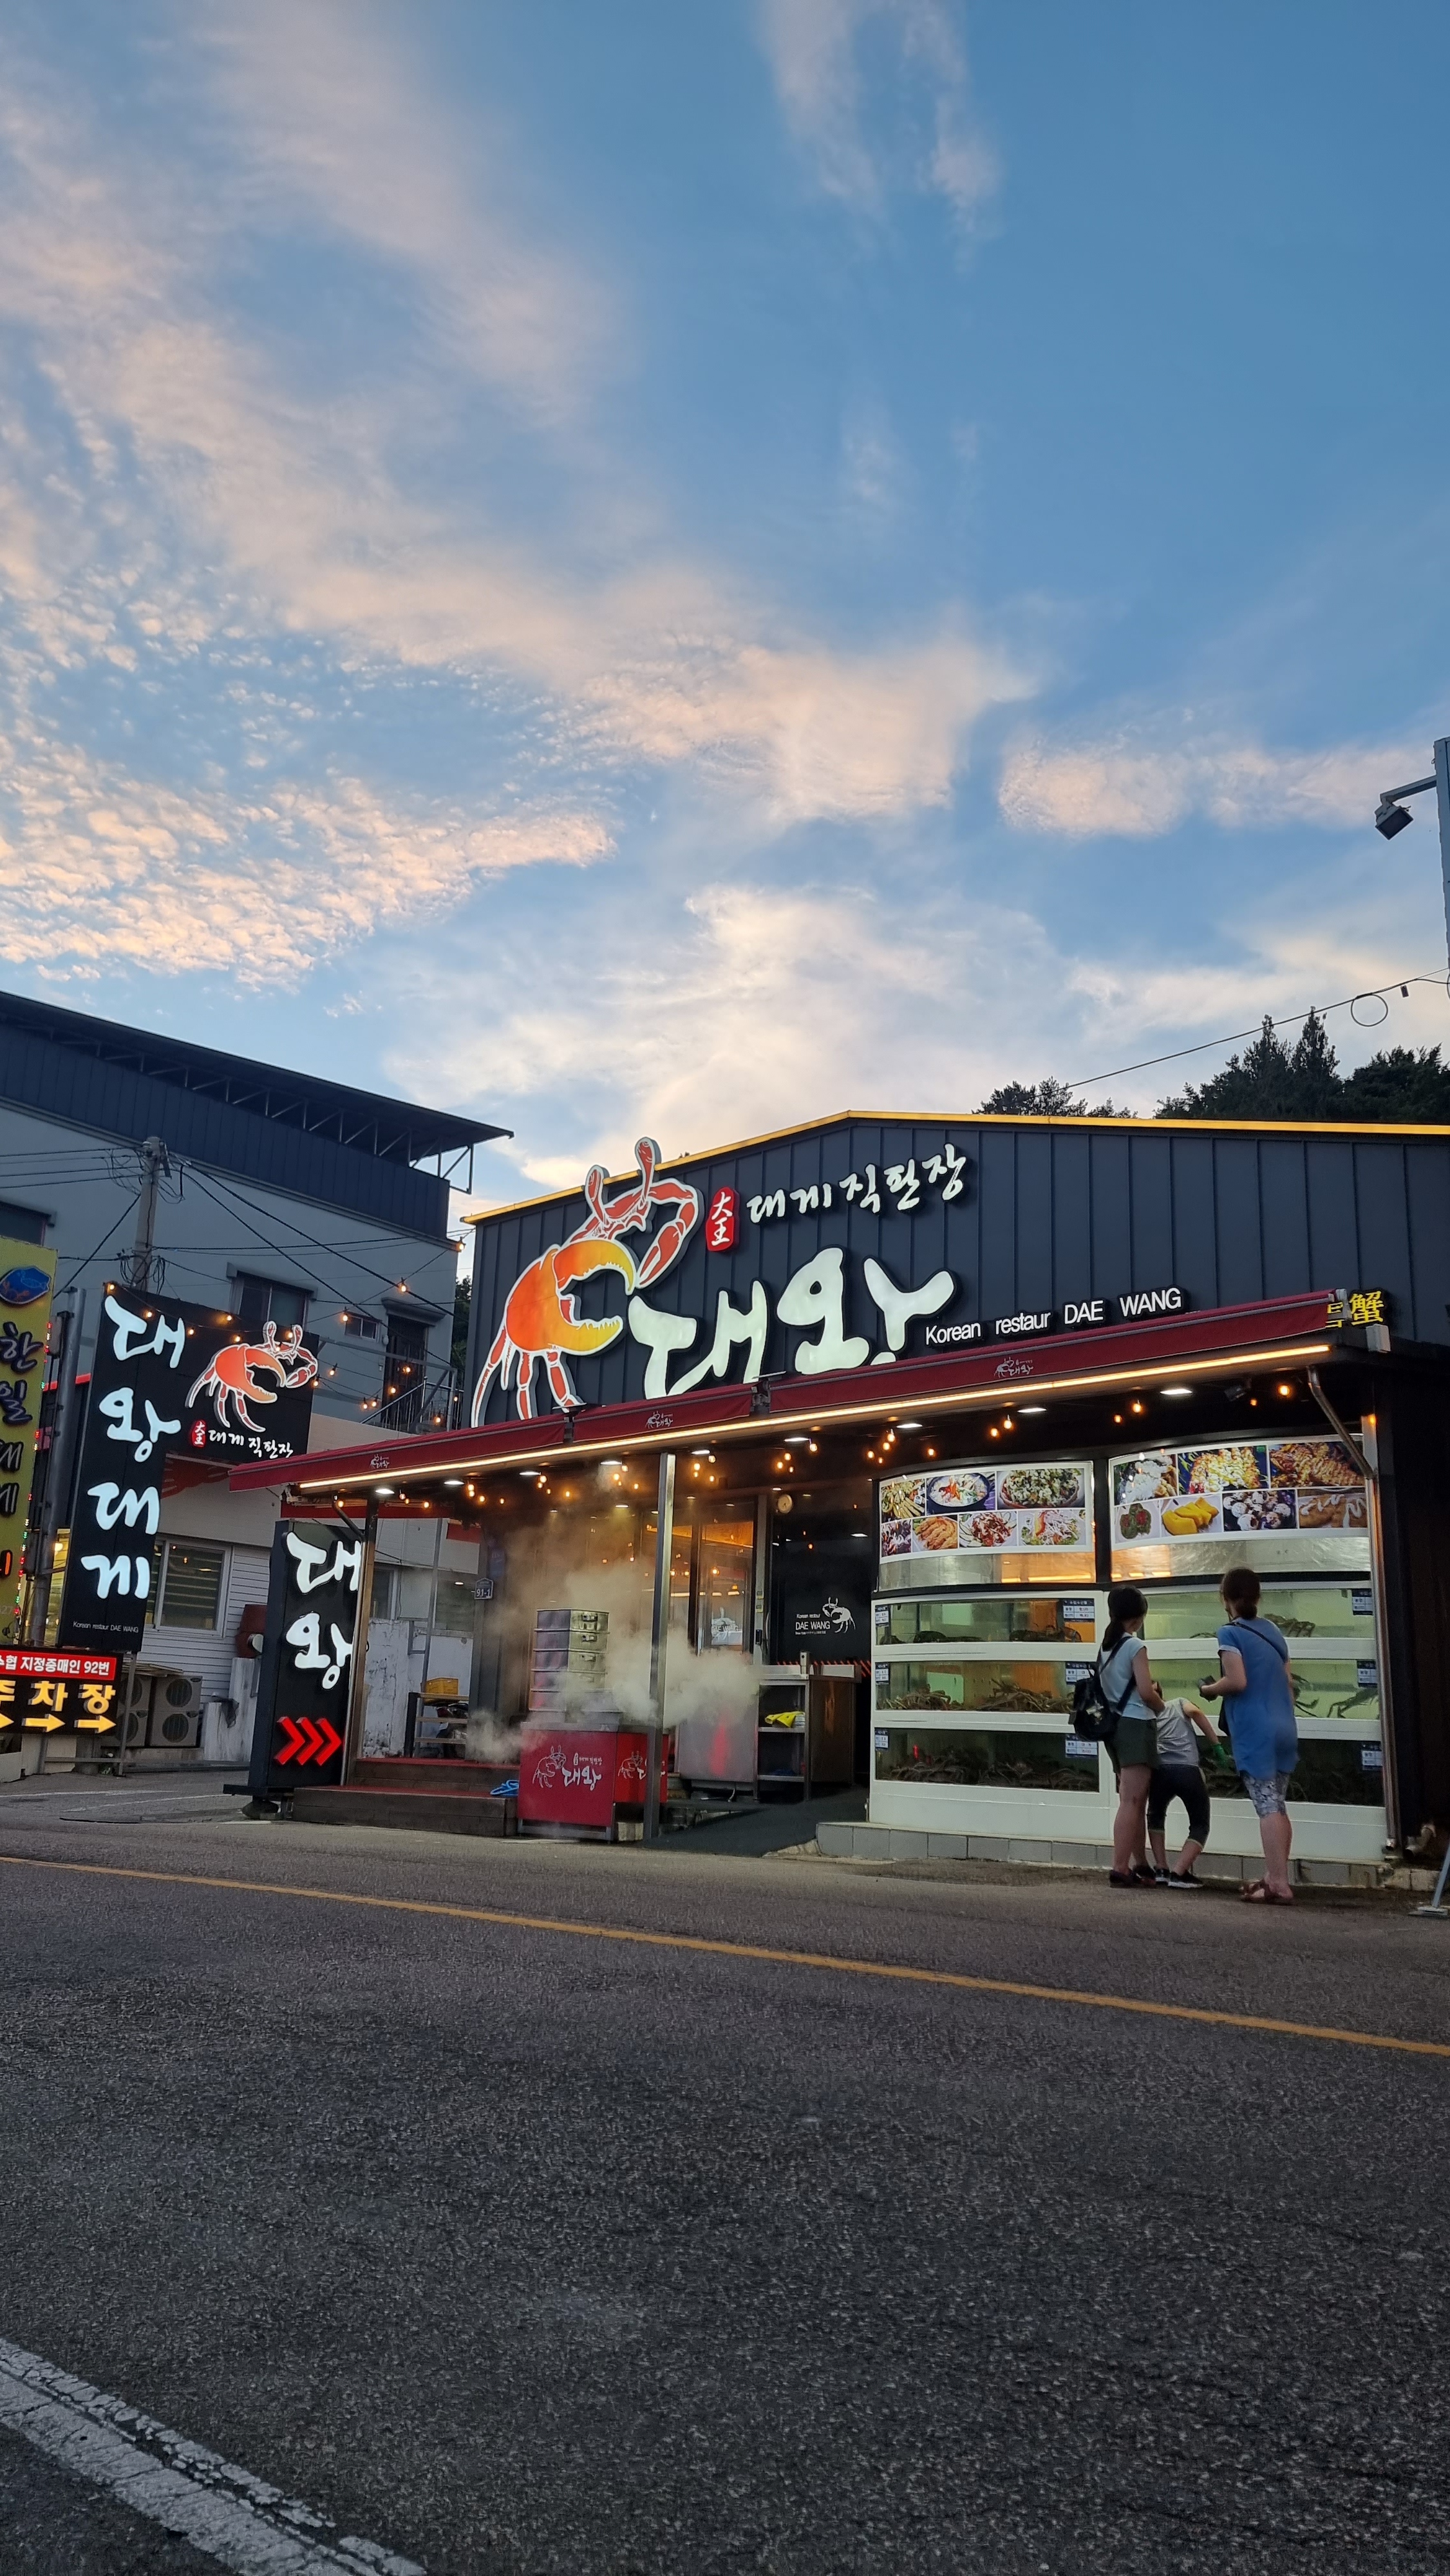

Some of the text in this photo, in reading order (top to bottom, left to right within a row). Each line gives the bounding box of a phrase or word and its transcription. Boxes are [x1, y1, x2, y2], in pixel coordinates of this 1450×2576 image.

[746, 1143, 966, 1224] 대게 직판장
[711, 1191, 733, 1247] 大王
[628, 1247, 955, 1400] 대왕
[925, 1287, 1182, 1345] Korean restaur DAE WANG
[207, 1429, 245, 1446] 대게
[476, 1588, 491, 1598] 91-1
[286, 1531, 362, 1690] 대왕
[73, 1621, 91, 1629] Korean
[795, 1620, 831, 1630] DAE WANG
[20, 1656, 81, 1674] 지정중매인
[84, 1660, 110, 1676] 92번
[561, 1765, 602, 1791] 대왕
